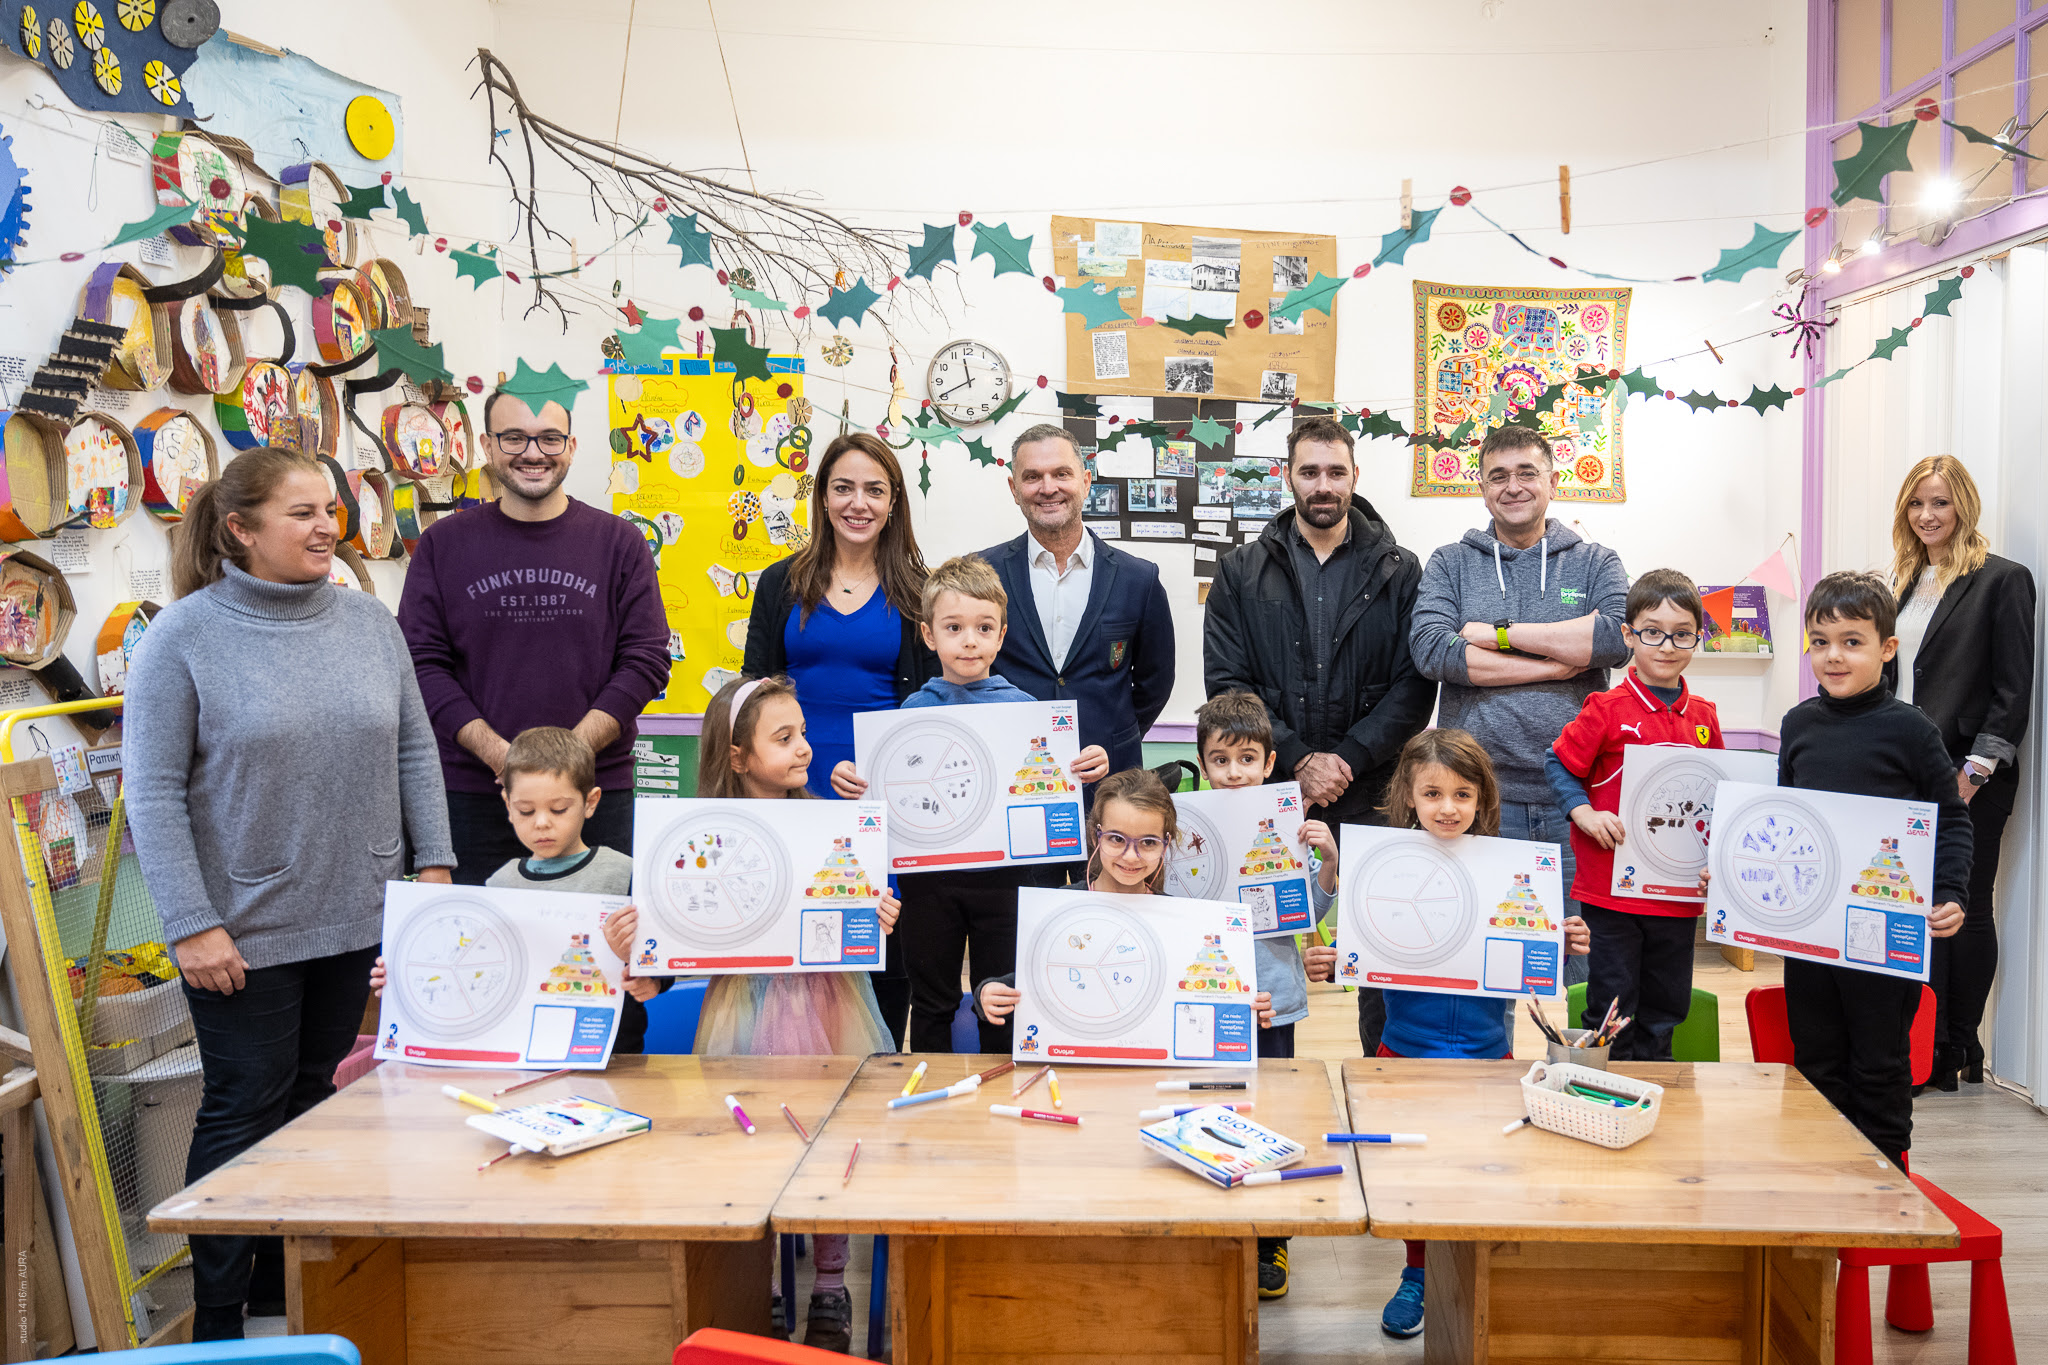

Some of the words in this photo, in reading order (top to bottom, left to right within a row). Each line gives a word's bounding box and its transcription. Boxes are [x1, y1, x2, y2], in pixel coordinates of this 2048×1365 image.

[466, 568, 598, 600] FUNKYBUDDHA
[500, 594, 567, 607] EST.1987
[89, 750, 121, 765] Ραπτική
[508, 1116, 562, 1136] GIOTTO
[1218, 1115, 1276, 1144] GIOTTO
